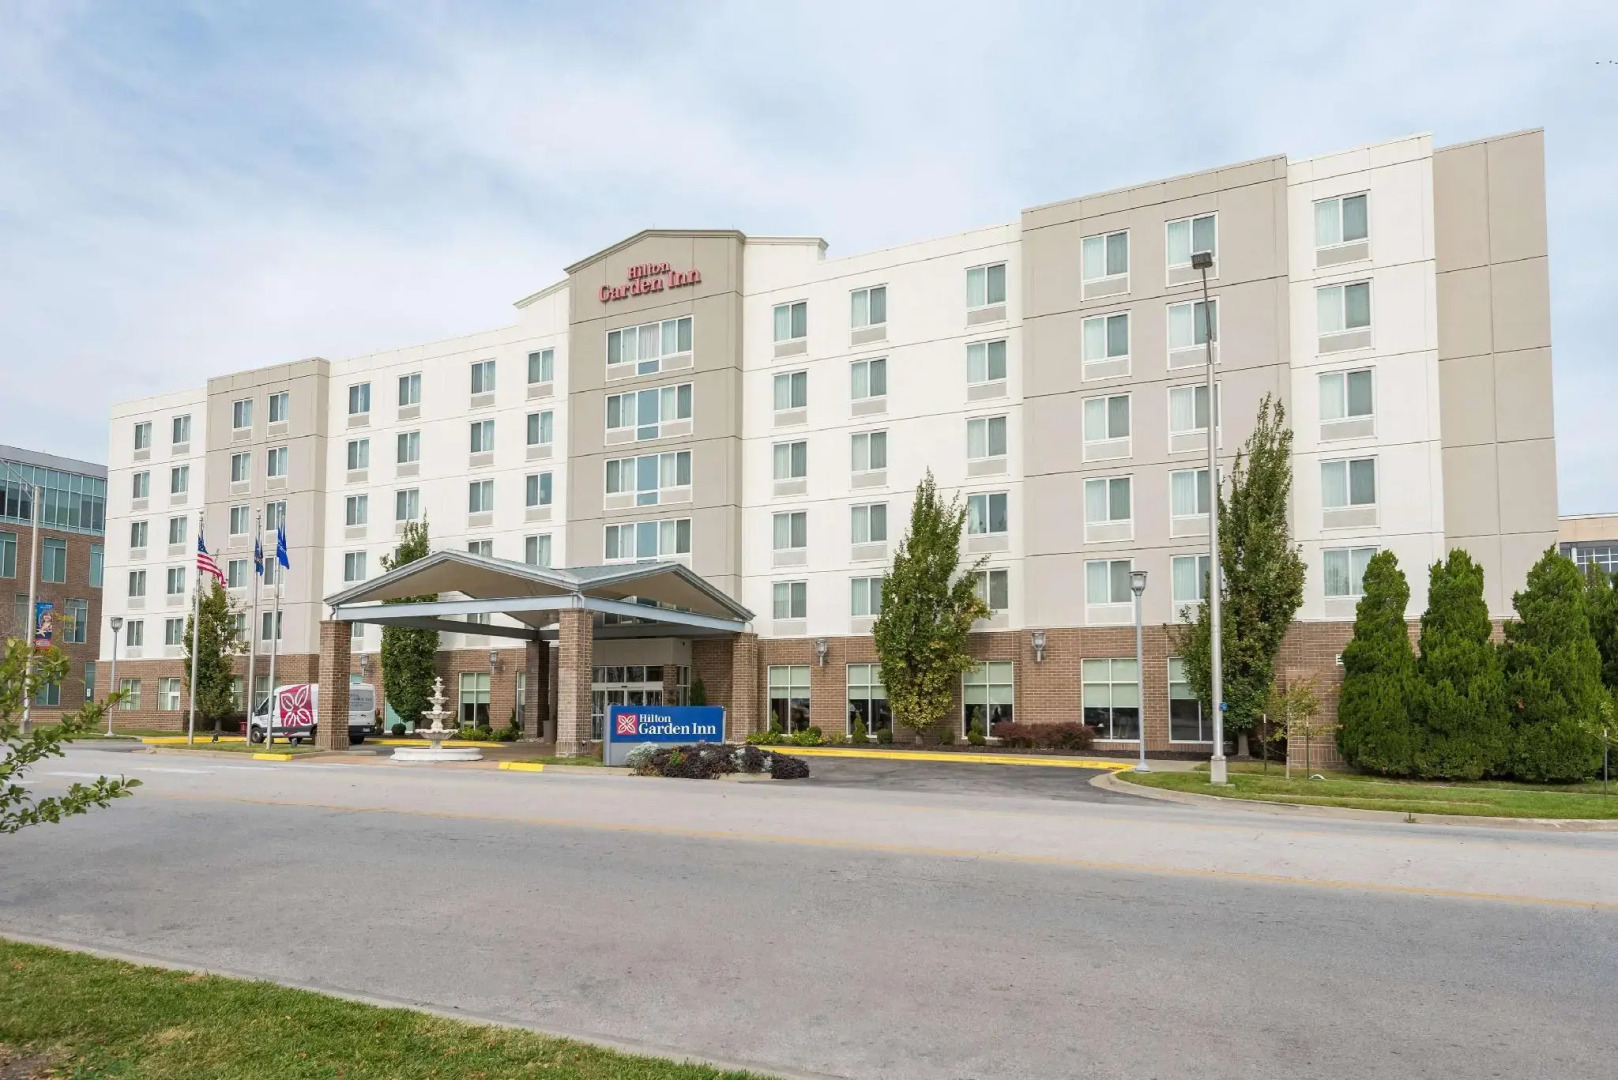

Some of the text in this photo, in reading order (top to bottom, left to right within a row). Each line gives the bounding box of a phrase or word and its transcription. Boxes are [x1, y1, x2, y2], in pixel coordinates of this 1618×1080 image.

[628, 262, 670, 280] Hilton
[598, 269, 701, 302] Garden Inn
[639, 714, 671, 723] Hilton
[638, 723, 716, 735] Garden Inn
